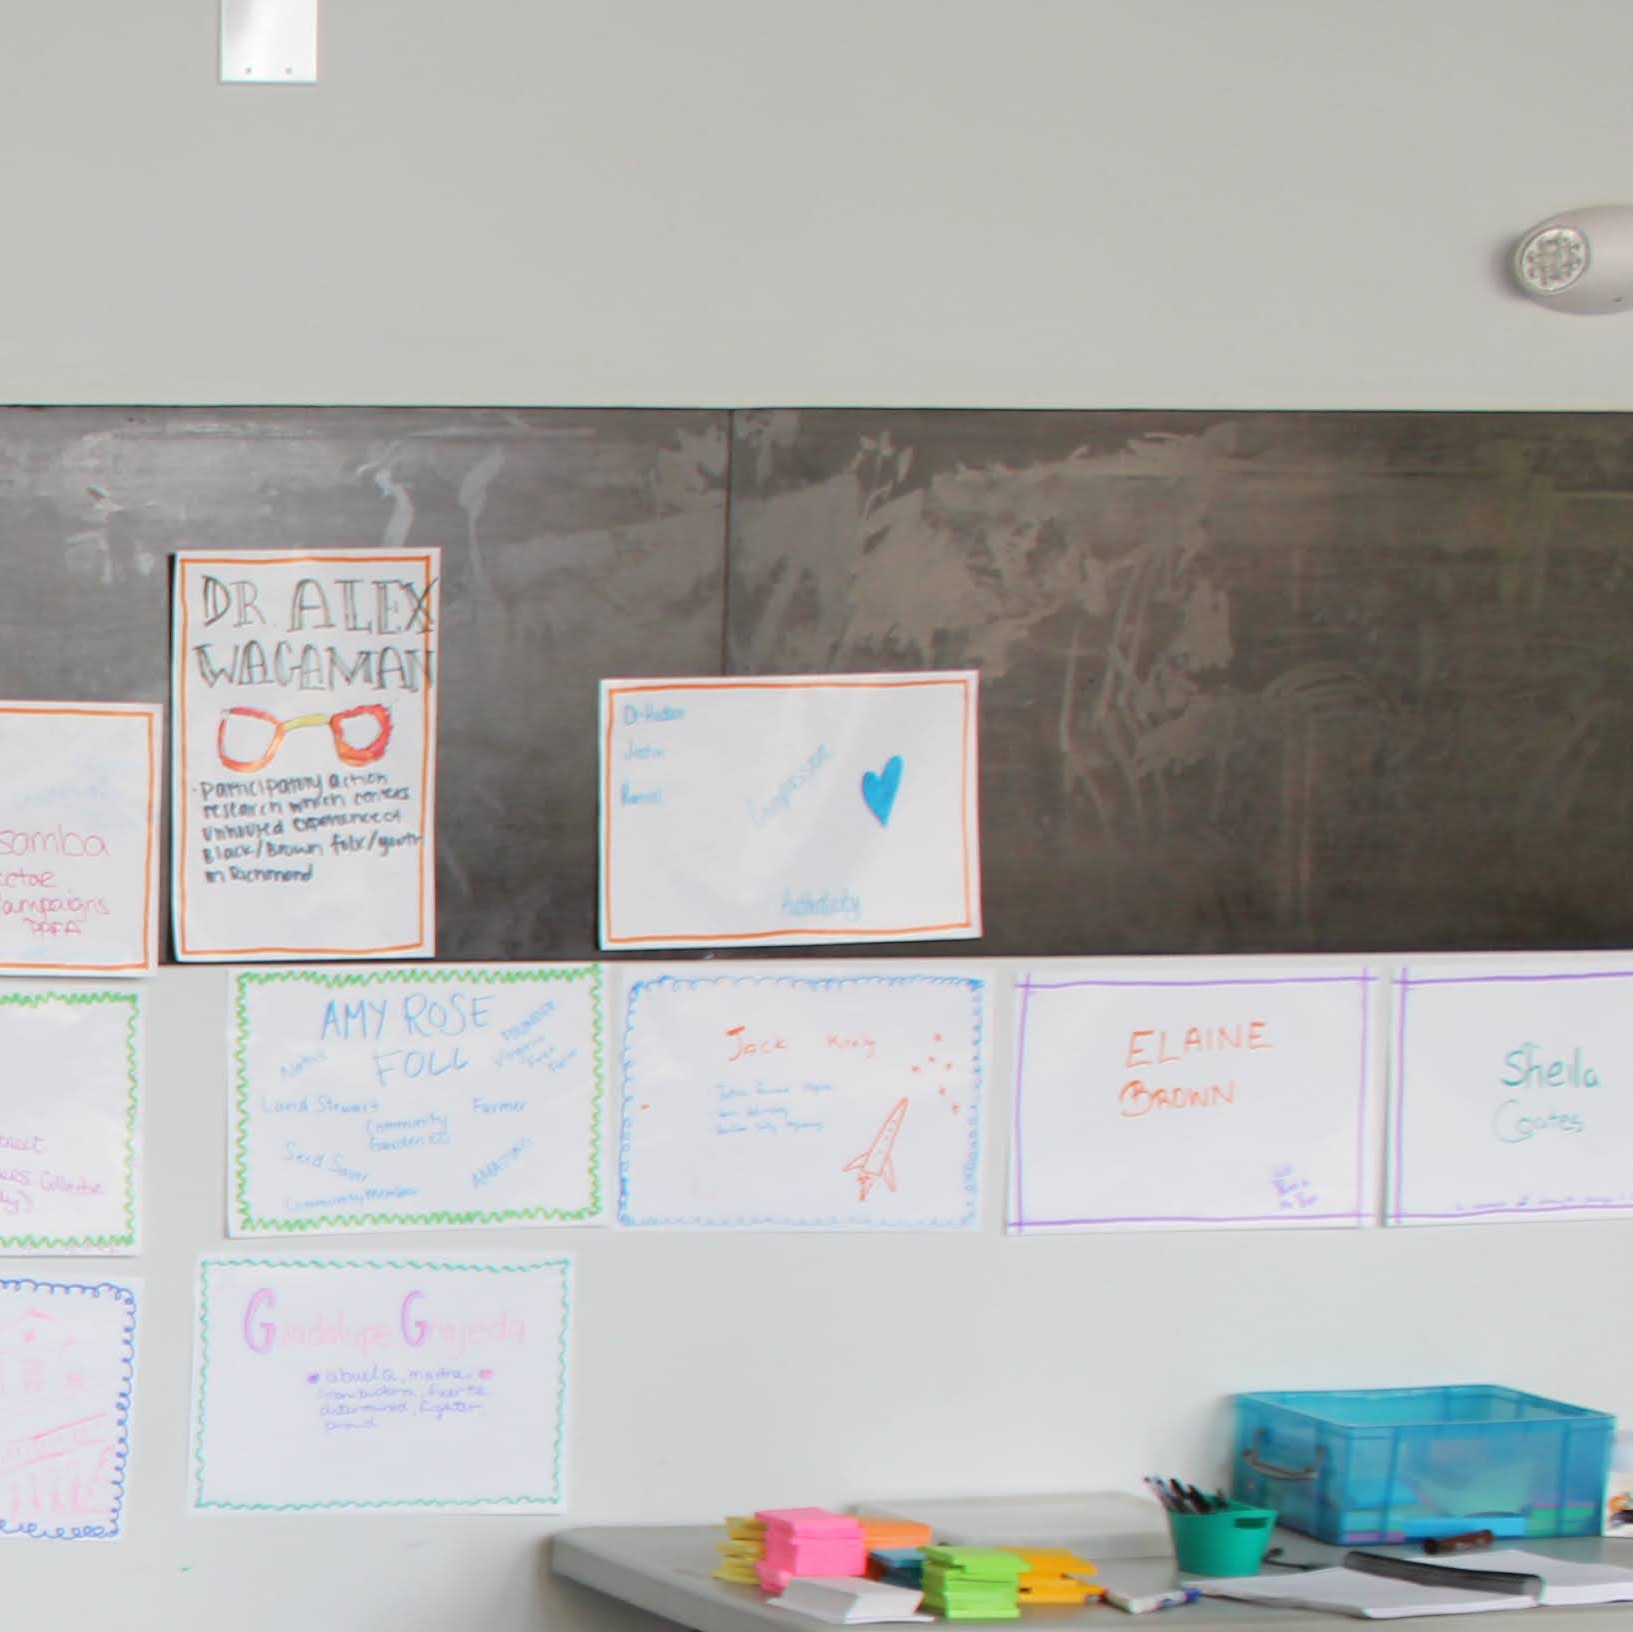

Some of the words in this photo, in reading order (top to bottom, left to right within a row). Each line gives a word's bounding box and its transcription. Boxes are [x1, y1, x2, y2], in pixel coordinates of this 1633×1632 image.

[286, 577, 439, 634] ALEX
[320, 999, 388, 1041] AMY
[403, 992, 495, 1037] ROSE
[1125, 1020, 1273, 1069] ELAINE
[1499, 1041, 1602, 1090] Sheila
